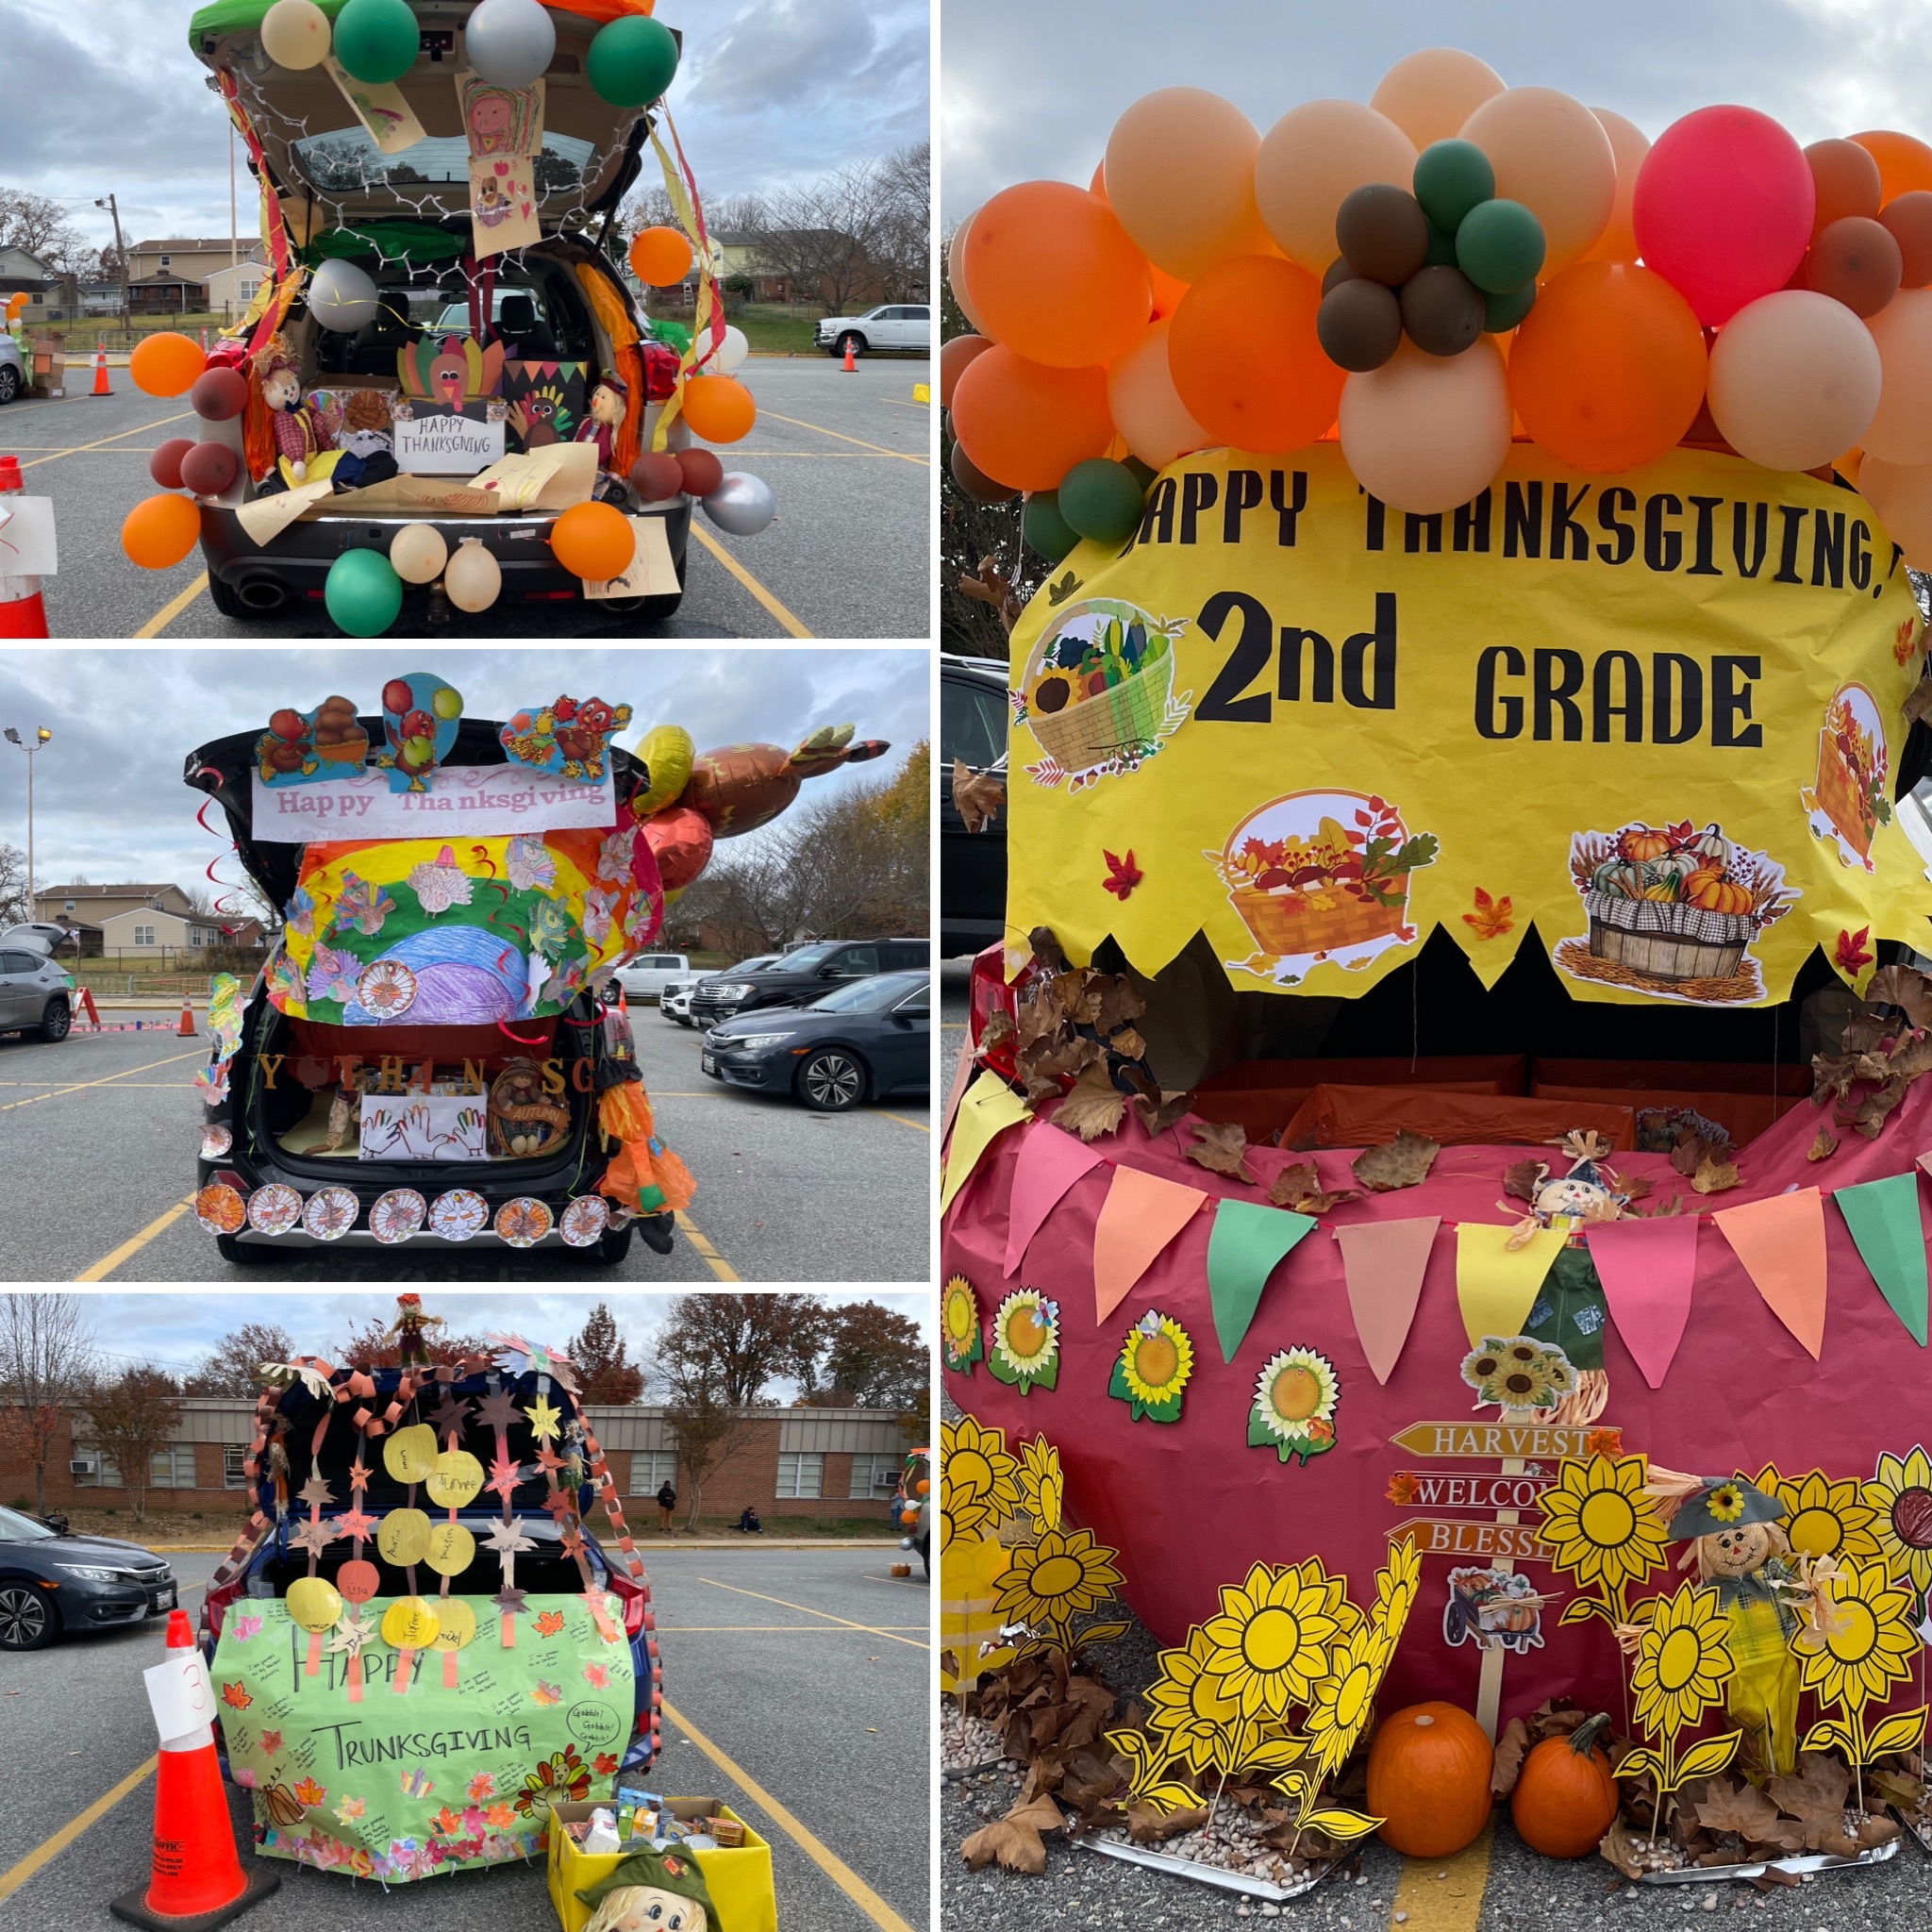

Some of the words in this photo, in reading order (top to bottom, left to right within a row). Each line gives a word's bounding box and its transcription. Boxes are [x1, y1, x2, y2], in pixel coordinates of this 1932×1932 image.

[420, 418, 465, 435] HAPPY
[402, 436, 491, 454] THANKSGIVING
[1117, 470, 1307, 558] APPY
[1194, 591, 1397, 724] 2nd
[1474, 645, 1762, 747] GRADE
[276, 791, 375, 818] Happy
[397, 782, 607, 814] Thanksgiving
[512, 1107, 561, 1123] AUTUMN
[1432, 1427, 1591, 1456] HARVEST
[1418, 1478, 1551, 1507] WELCO
[1428, 1524, 1556, 1558] BLESSE
[347, 1582, 368, 1595] Lisa
[184, 1664, 207, 1710] 3
[573, 1707, 604, 1720] Gobble!
[583, 1721, 614, 1733] Gobble!
[311, 1721, 531, 1771] TRUNKSGIVING
[580, 1732, 609, 1741] Gobble!
